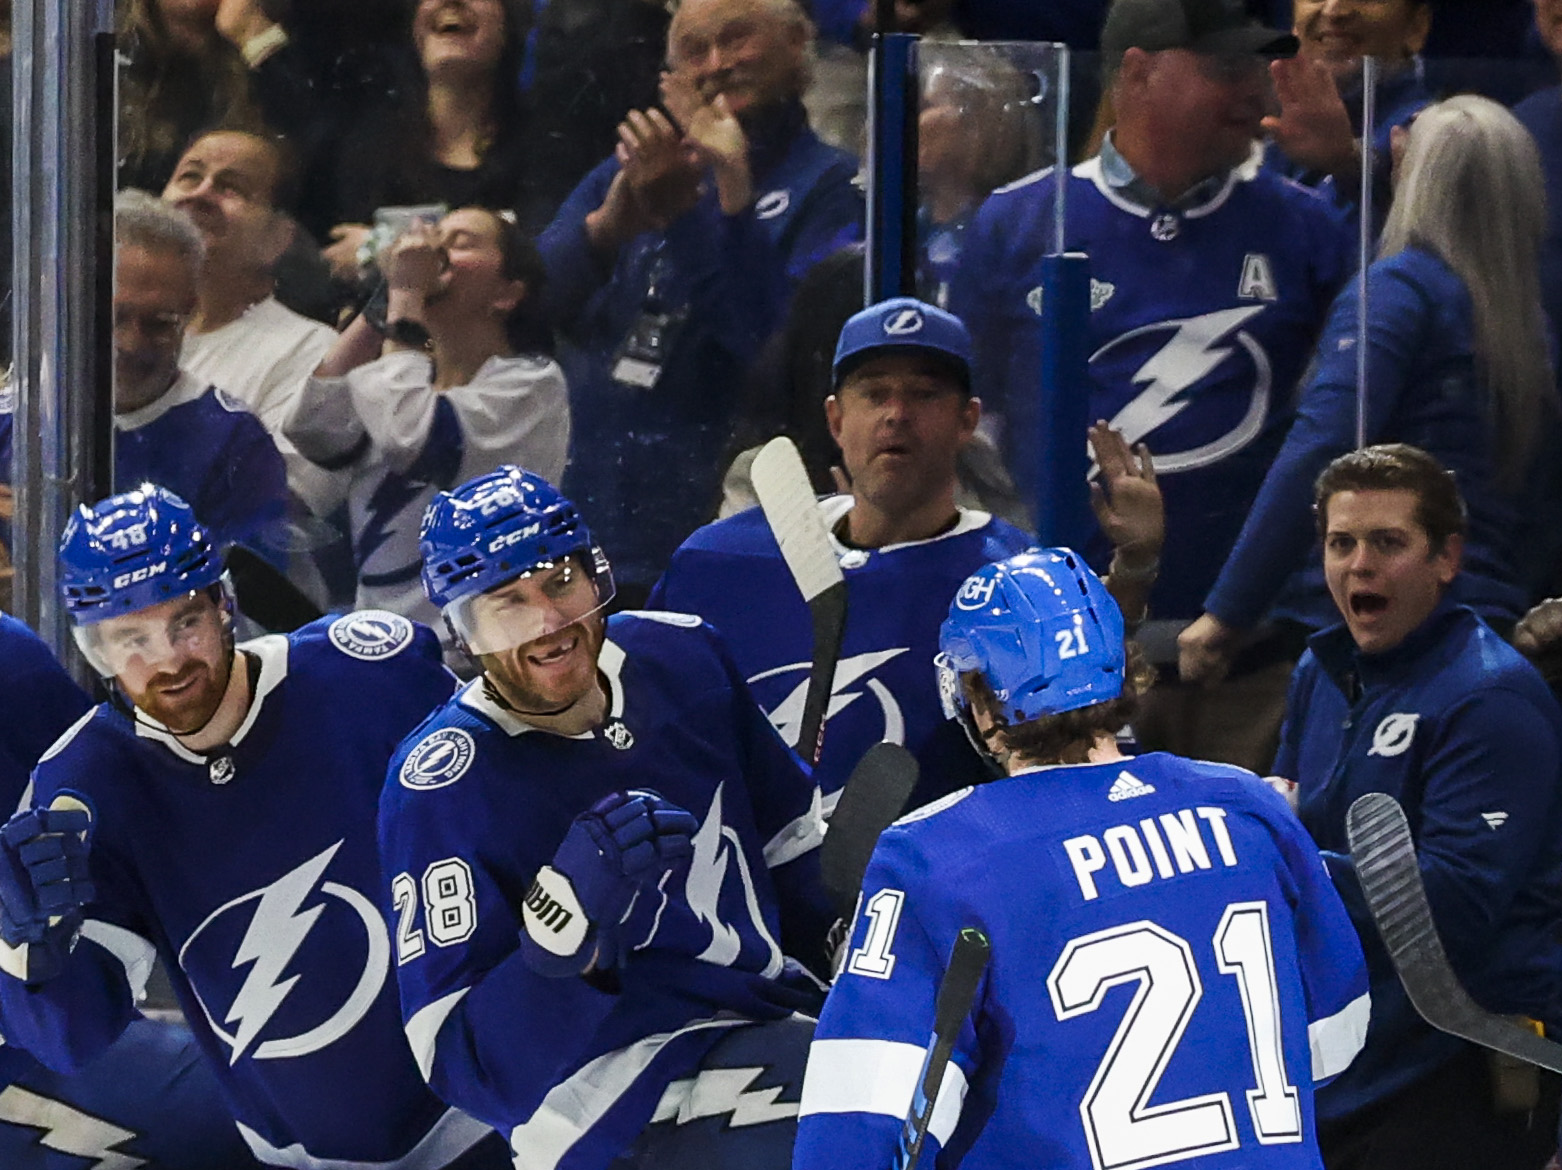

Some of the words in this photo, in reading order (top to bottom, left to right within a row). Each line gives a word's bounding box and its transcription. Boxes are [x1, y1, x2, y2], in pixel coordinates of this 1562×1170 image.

[1237, 254, 1278, 301] A
[488, 522, 540, 553] CCM
[113, 560, 167, 589] CCM
[1054, 627, 1090, 660] 21
[1107, 783, 1157, 803] adidas
[1063, 806, 1238, 901] POINT
[392, 856, 478, 967] 28
